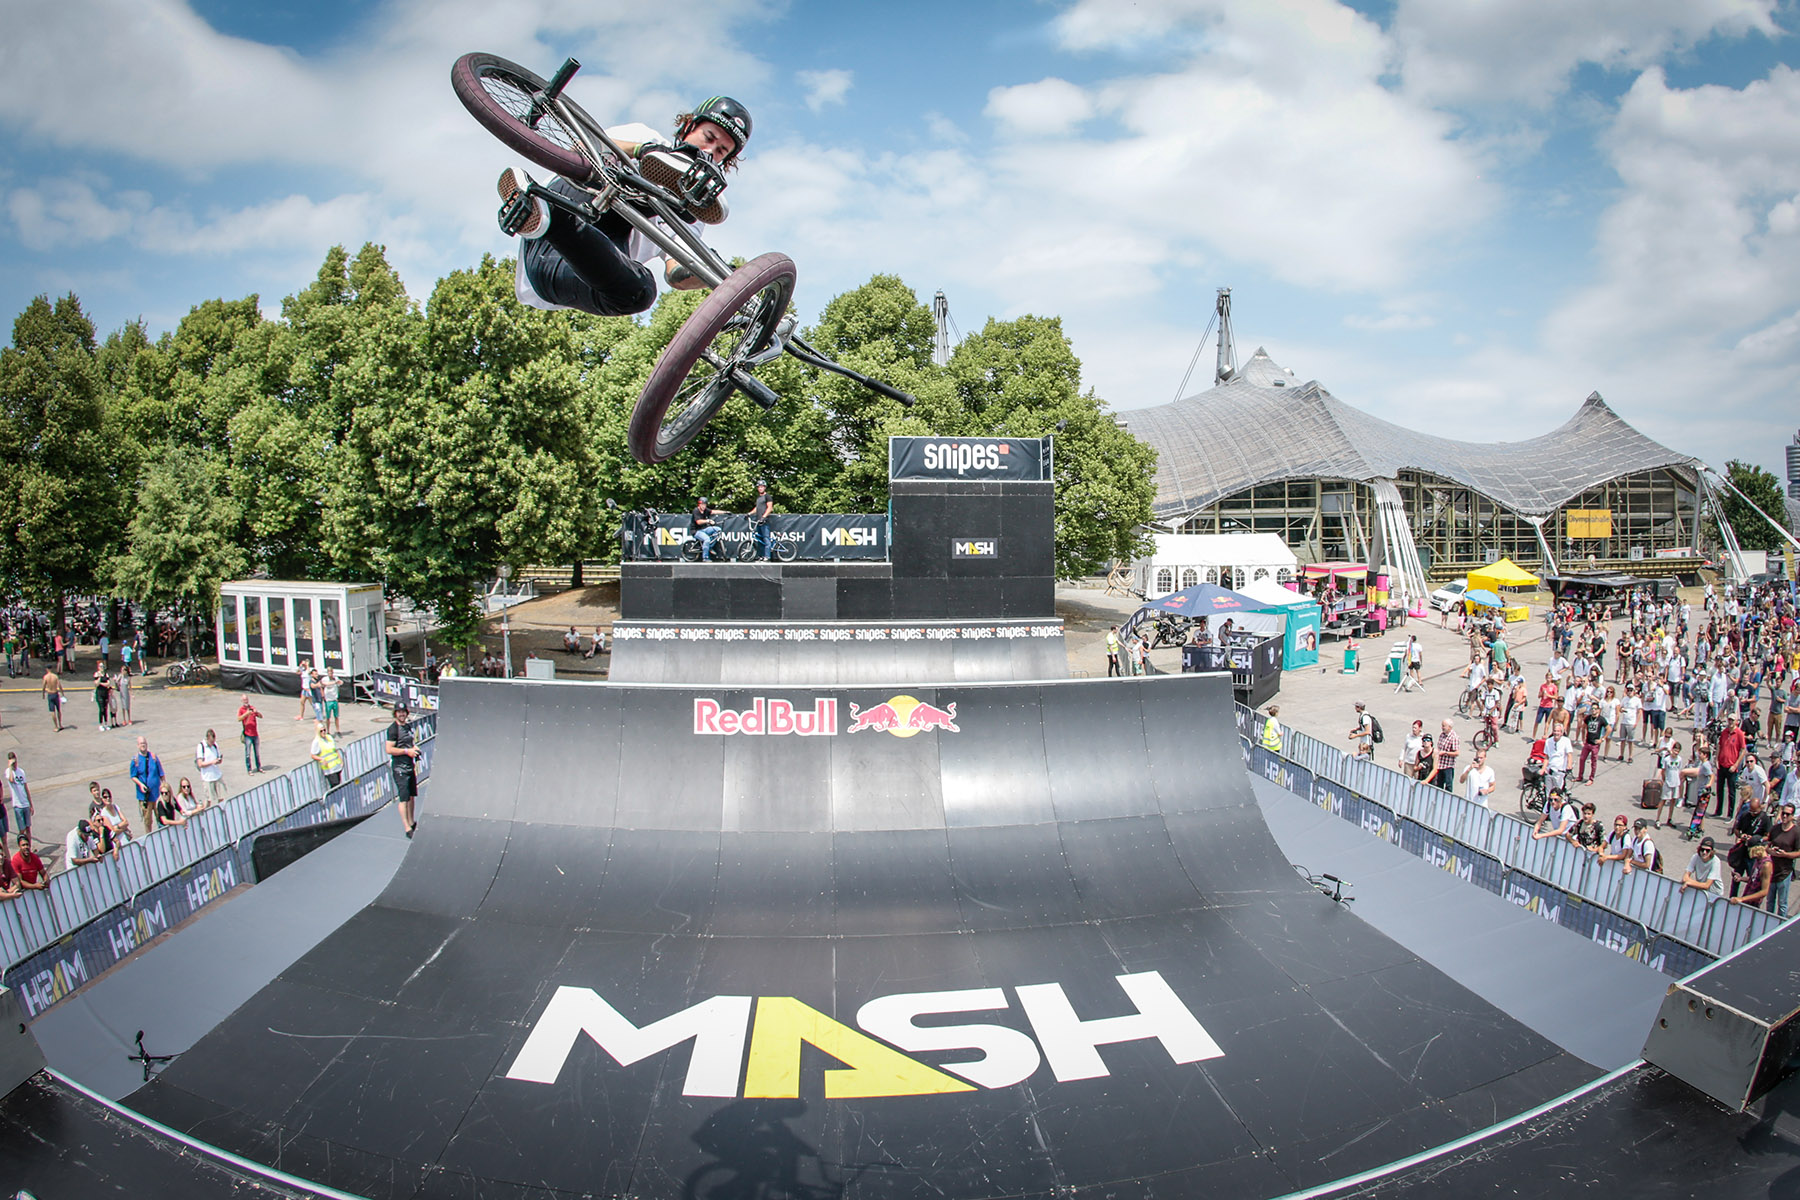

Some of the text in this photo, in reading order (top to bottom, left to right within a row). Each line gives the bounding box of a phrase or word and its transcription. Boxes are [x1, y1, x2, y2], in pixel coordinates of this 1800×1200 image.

[924, 443, 1000, 475] snipes
[1568, 515, 1610, 523] Olympiahalle
[821, 528, 877, 546] MASH
[955, 542, 994, 555] MASH
[613, 625, 1060, 642] snipes snipes snipes snipes snipes snipes snipes snipes snipes snipes snipes snipes snipes
[377, 679, 400, 696] MASH
[694, 697, 837, 736] Red Bull
[505, 970, 1226, 1099] MASH
